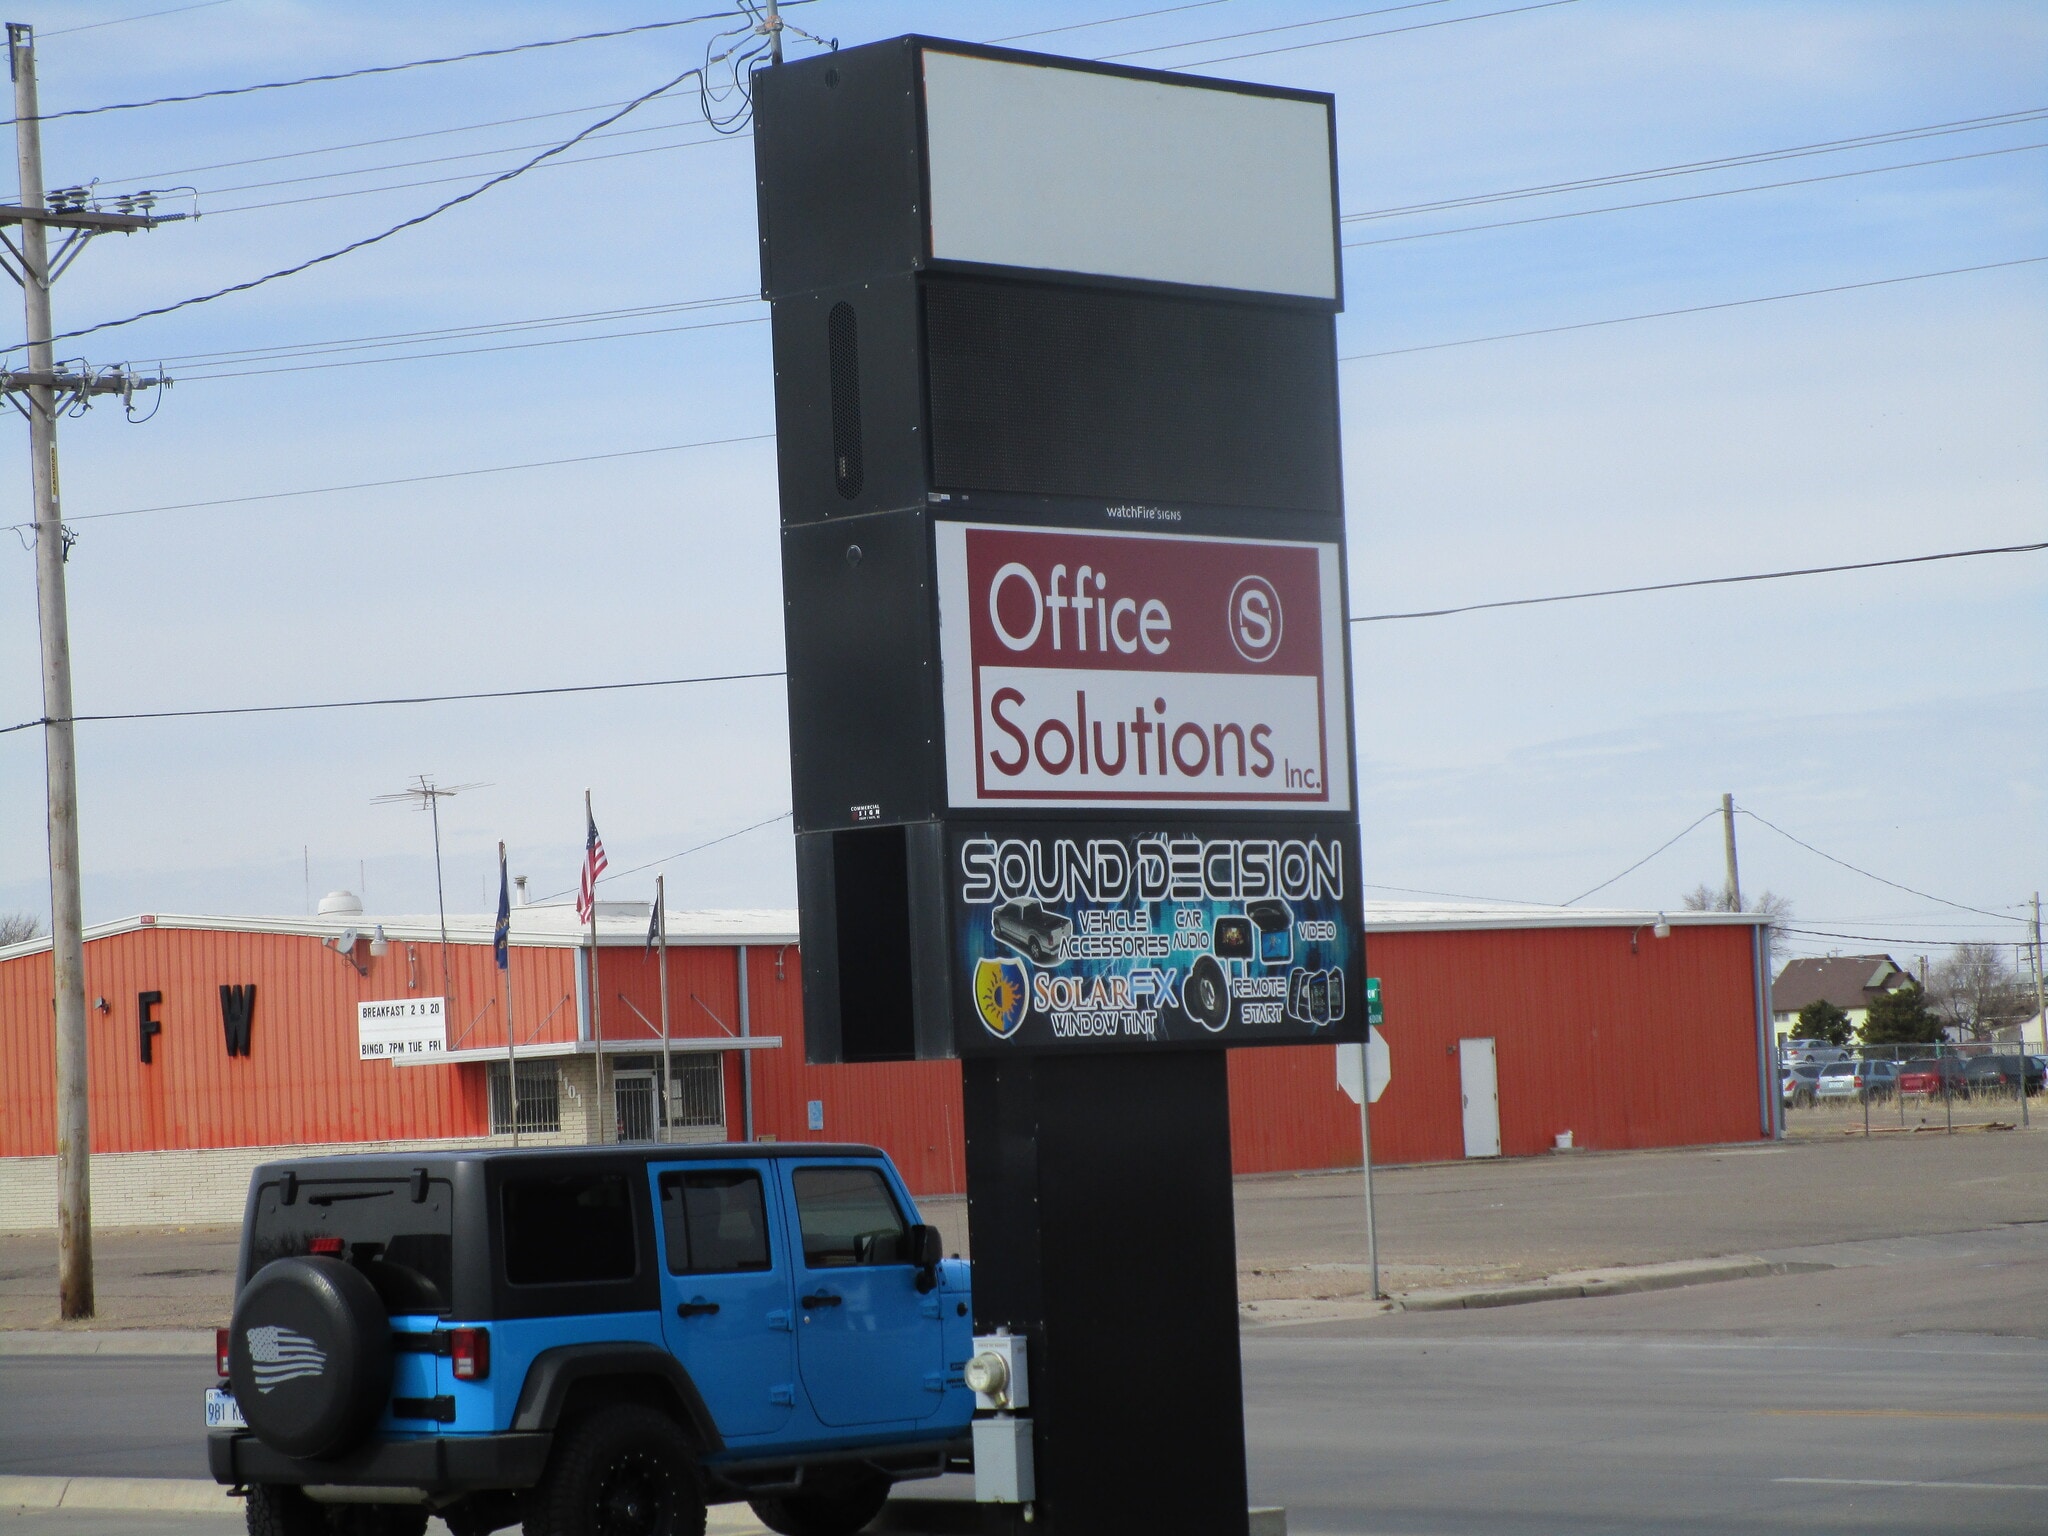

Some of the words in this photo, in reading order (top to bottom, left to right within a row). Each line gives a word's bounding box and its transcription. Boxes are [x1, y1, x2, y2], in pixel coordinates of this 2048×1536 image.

[1157, 510, 1182, 521] SIGNS
[989, 562, 1172, 655] Office
[989, 686, 1275, 779] Solutions
[1284, 758, 1321, 790] Inc.
[961, 839, 1130, 903] SOUND
[1137, 838, 1343, 900] DECISION
[1078, 909, 1147, 933] VEHICLE
[1175, 909, 1202, 928] CAR
[1173, 931, 1210, 949] AUDIO
[1298, 920, 1337, 942] VIDEO
[1058, 934, 1170, 959] ACCESSORIES
[1233, 977, 1287, 999] REMOTE
[362, 1005, 404, 1018] BREAKFAST
[411, 1004, 416, 1015] 2
[420, 1004, 425, 1015] 9
[430, 1003, 440, 1014] 20
[1242, 1002, 1285, 1024] START
[138, 990, 162, 1064] F
[219, 984, 256, 1057] W
[1050, 1011, 1119, 1038] WINDOW
[1120, 1010, 1158, 1033] TINT
[361, 1043, 384, 1055] BINGO
[389, 1042, 405, 1053] 7PM
[408, 1041, 422, 1052] TUE
[429, 1040, 441, 1051] FRI
[557, 1068, 582, 1108] 1101
[208, 1403, 224, 1420] 981
